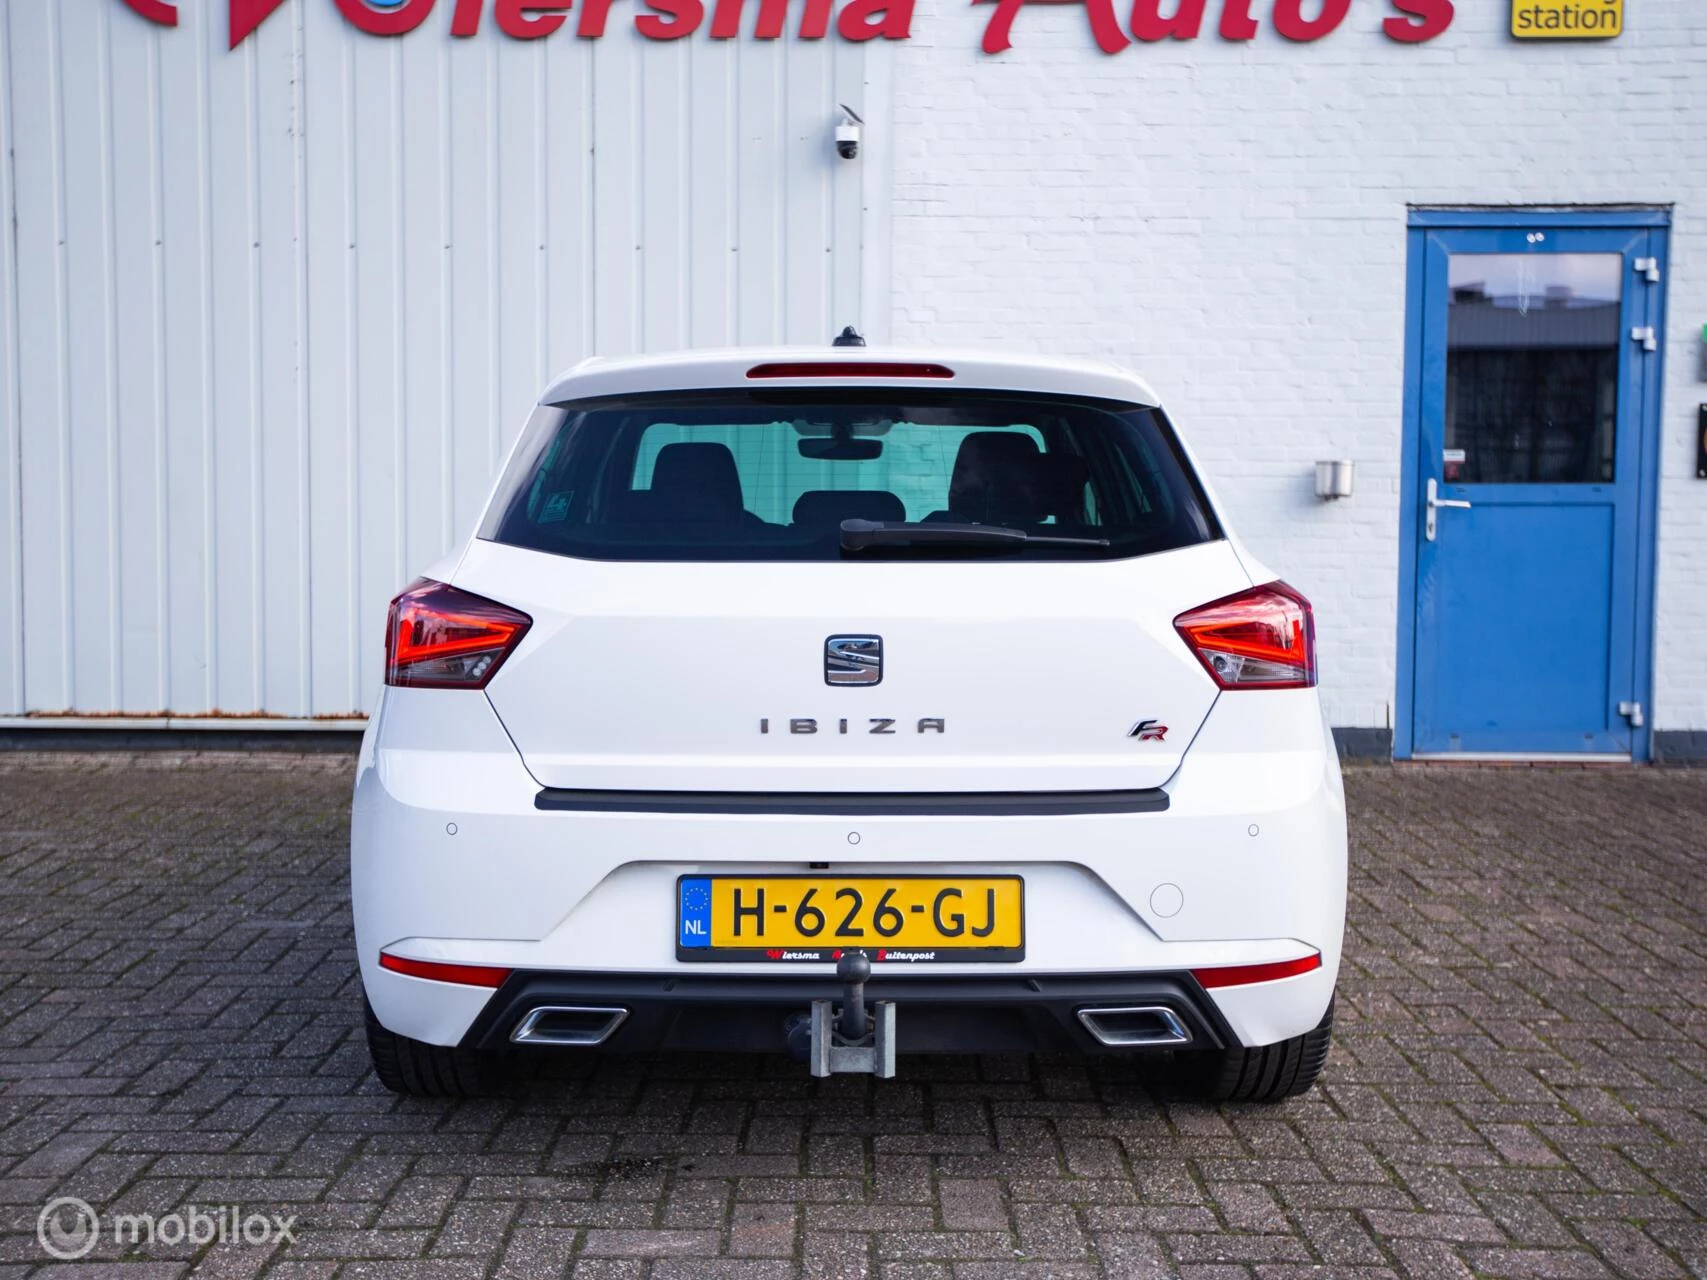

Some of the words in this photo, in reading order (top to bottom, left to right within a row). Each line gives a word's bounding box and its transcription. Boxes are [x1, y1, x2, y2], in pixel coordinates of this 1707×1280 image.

[119, 0, 911, 50] iersma
[1518, 4, 1617, 29] station
[760, 718, 945, 734] IBIZA
[1128, 719, 1169, 742] FR
[733, 888, 995, 938] H-626-GJ
[685, 919, 707, 935] NL
[766, 949, 820, 960] Wiersma
